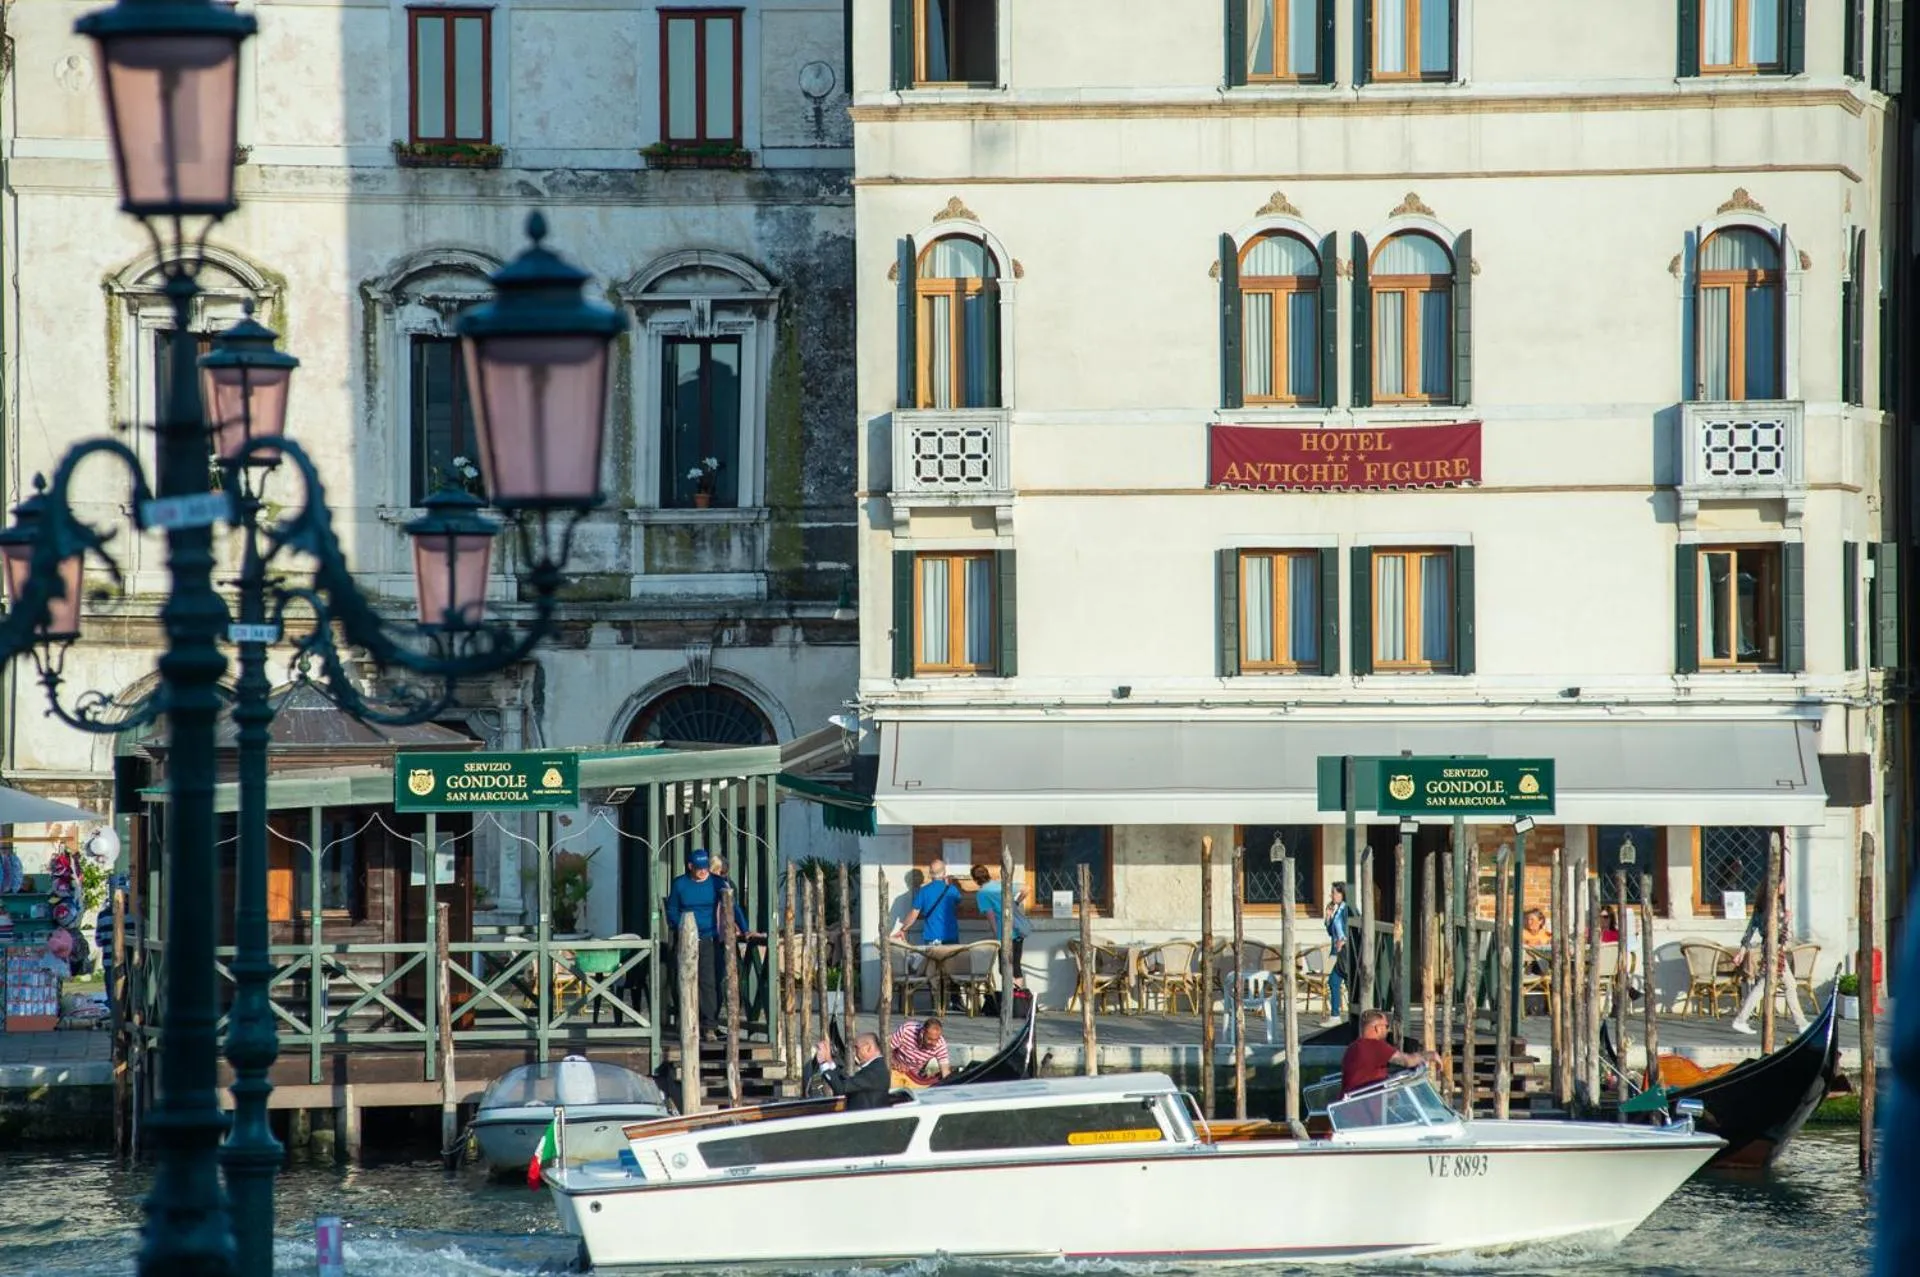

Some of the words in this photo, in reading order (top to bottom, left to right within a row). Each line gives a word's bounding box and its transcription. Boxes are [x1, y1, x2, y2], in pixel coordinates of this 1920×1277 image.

[1301, 432, 1392, 451] HOTEL
[1223, 461, 1349, 482] ANTICHE
[1364, 458, 1471, 481] FIGURE
[464, 762, 512, 772] SERVIZIO
[1443, 768, 1489, 778] SERVIZIO
[446, 775, 527, 788] GONDOLE
[1426, 781, 1504, 793] GONDOLE
[446, 792, 467, 801] SAN
[469, 792, 529, 801] MARCUOLA
[1426, 797, 1446, 806] SAN
[1448, 797, 1506, 806] MARCUOLA
[1094, 1131, 1114, 1140] TAXI
[1428, 1155, 1450, 1177] VE
[1454, 1154, 1488, 1177] 8893
